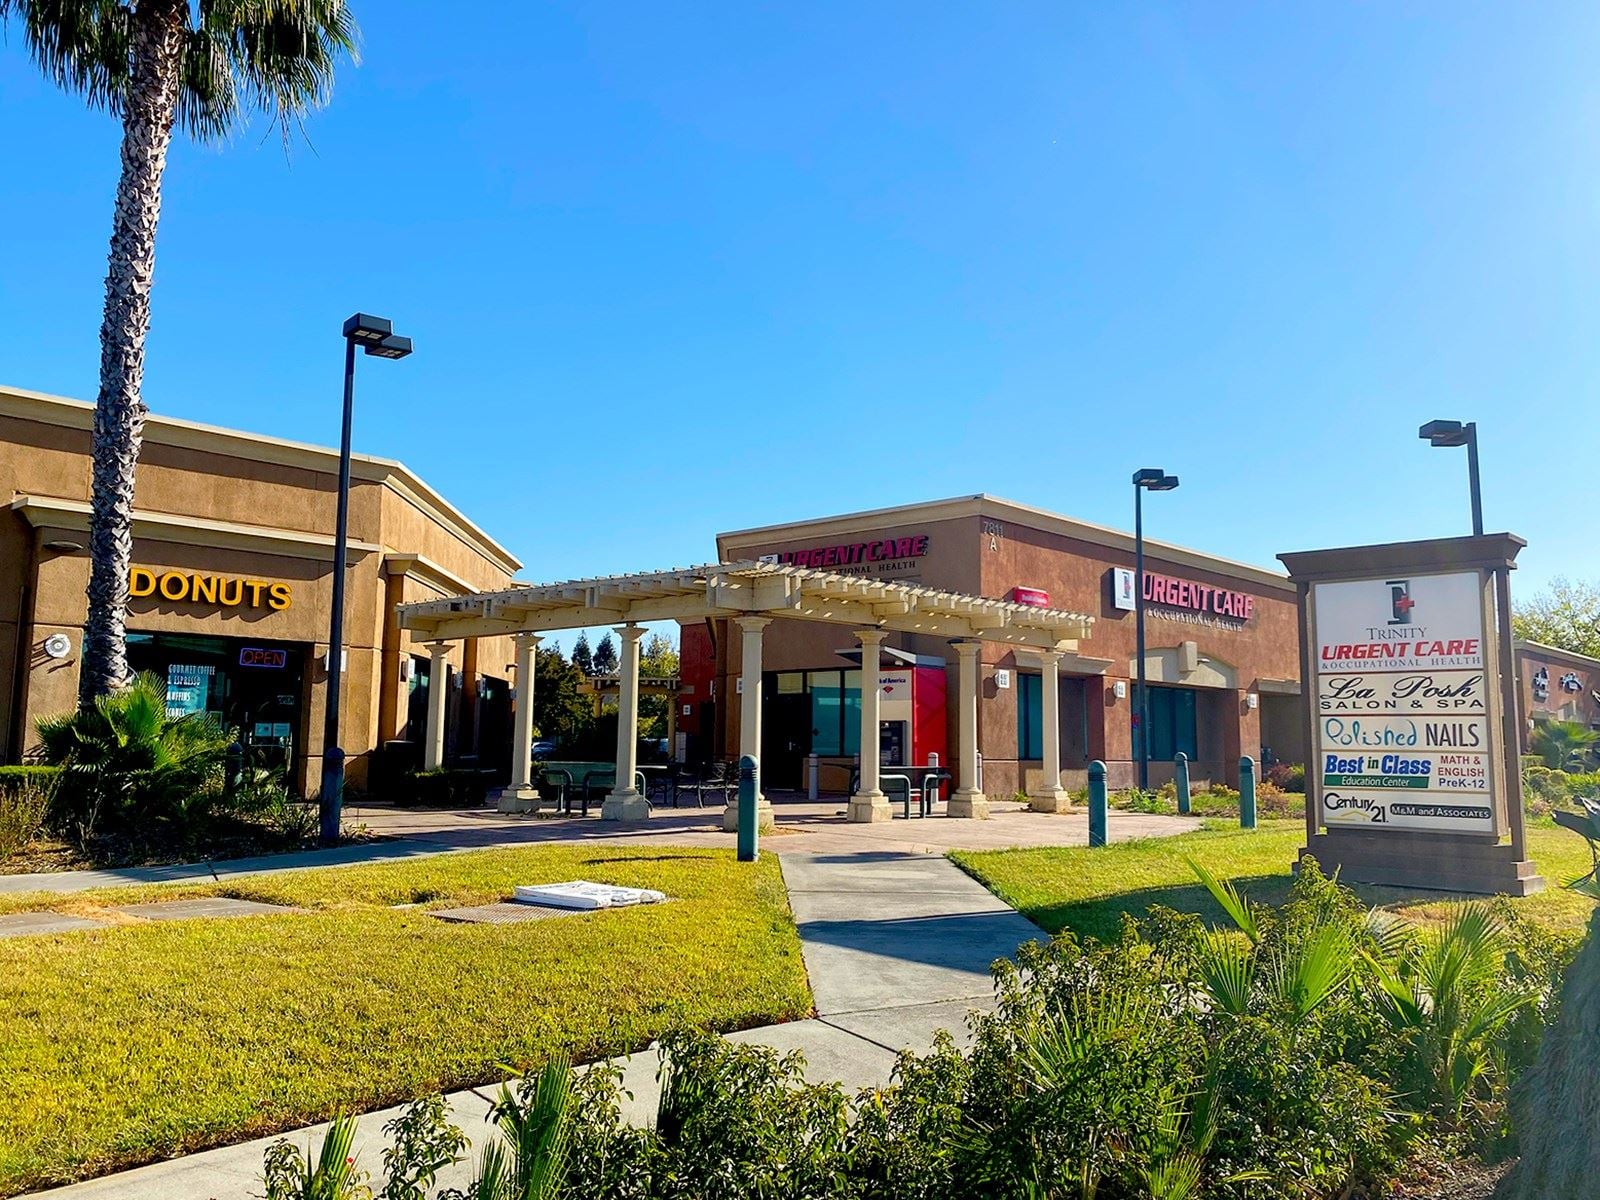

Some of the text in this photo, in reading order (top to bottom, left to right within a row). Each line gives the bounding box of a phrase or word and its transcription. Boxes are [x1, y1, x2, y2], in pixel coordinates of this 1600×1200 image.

[983, 521, 1004, 538] 7811
[866, 534, 928, 562] CARE
[989, 537, 998, 552] A
[878, 560, 916, 572] HEALTH
[129, 568, 293, 610] DONUTS
[1142, 573, 1256, 619] URGENT CARE
[1216, 616, 1242, 632] HEALTH
[1366, 627, 1428, 640] TRINITY
[242, 650, 284, 665] OPEN
[1321, 640, 1479, 660] URGENT CARE
[1431, 656, 1480, 666] HEALTH
[168, 664, 216, 676] GOURMET COFFEE
[174, 676, 200, 686] ESPRESSO
[1320, 675, 1483, 700] La Posh
[1320, 699, 1484, 710] SALON & SPA
[1326, 718, 1480, 747] Polished NAILS
[1324, 754, 1432, 776] Best in Class
[1440, 756, 1481, 764] MATH &
[1438, 767, 1484, 777] ENGLISH
[1342, 776, 1410, 787] Education Center
[1439, 778, 1485, 788] PreK-12
[1324, 792, 1375, 812] Century
[1391, 806, 1416, 815] M&M
[1436, 808, 1489, 818] ASSOCIATES
